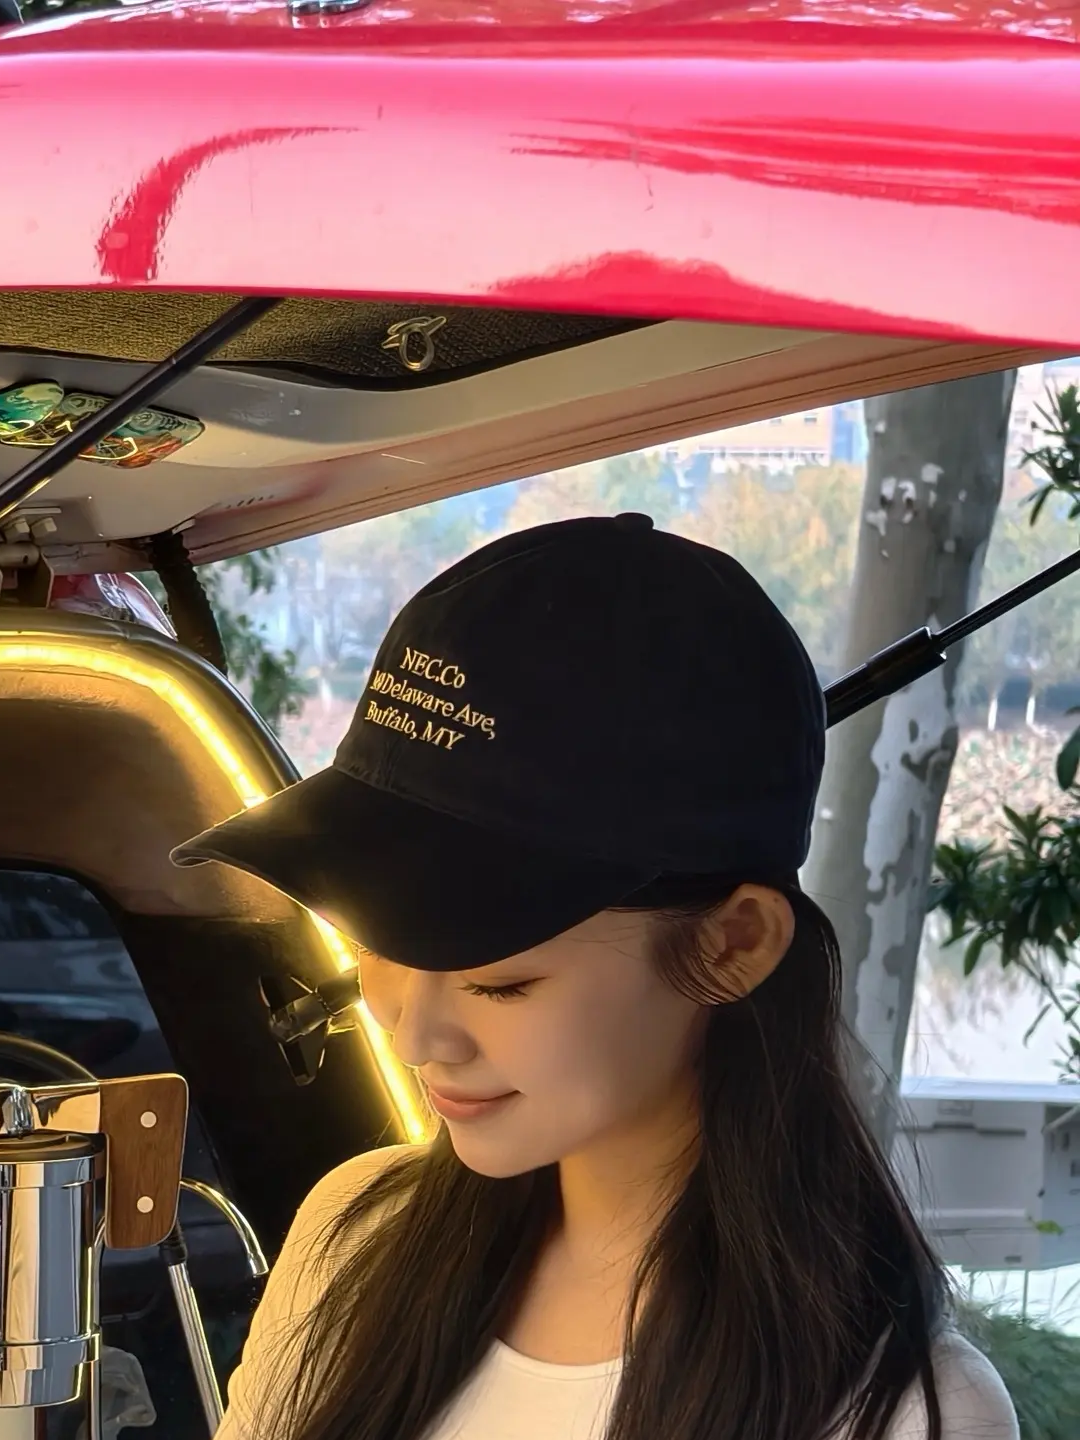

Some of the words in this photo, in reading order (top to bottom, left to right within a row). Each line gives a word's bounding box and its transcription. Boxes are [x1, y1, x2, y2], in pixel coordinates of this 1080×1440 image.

[400, 647, 466, 689] NEC.Co
[364, 700, 418, 740] Buffalo,
[452, 703, 497, 740] Ave,
